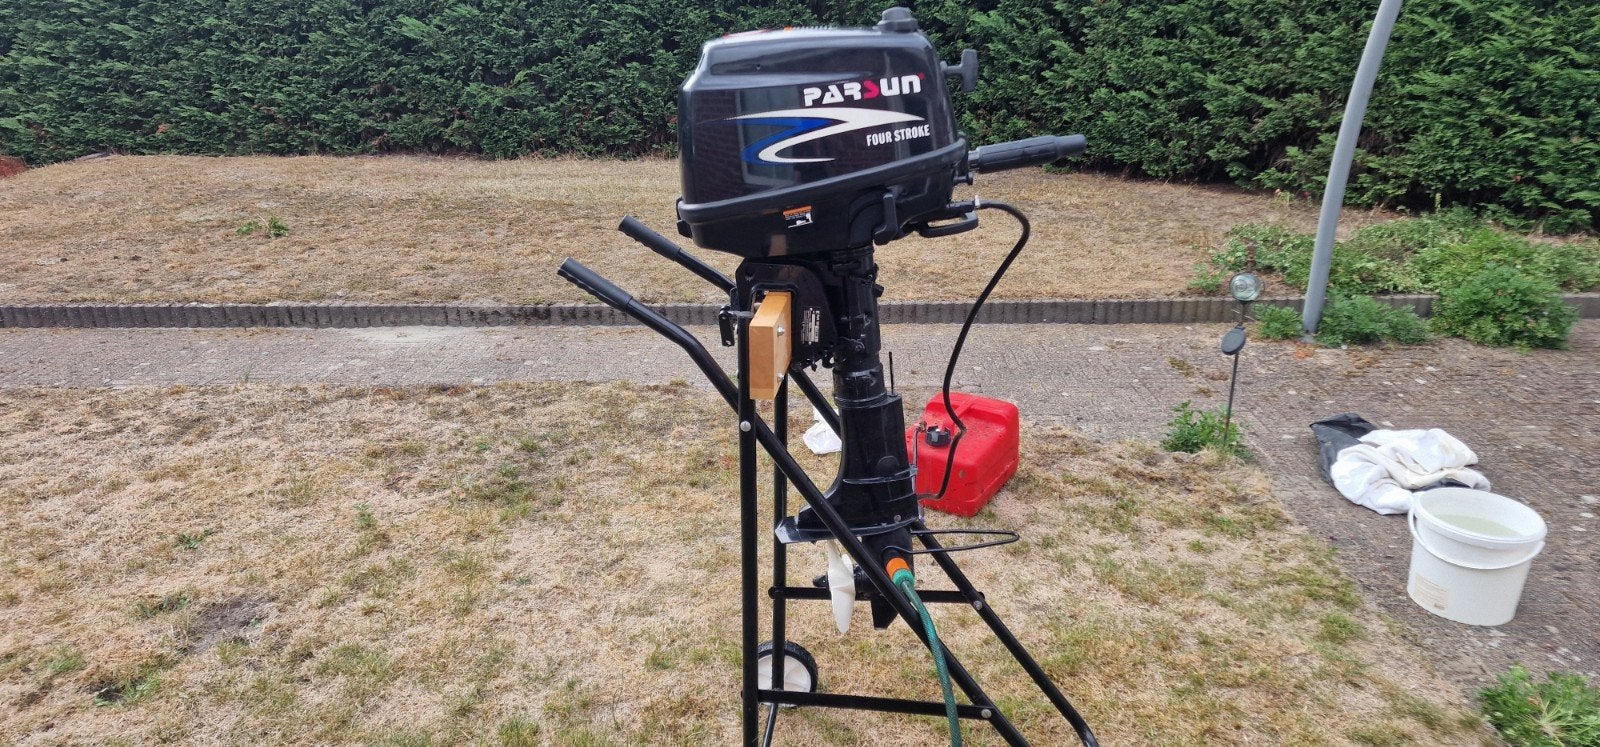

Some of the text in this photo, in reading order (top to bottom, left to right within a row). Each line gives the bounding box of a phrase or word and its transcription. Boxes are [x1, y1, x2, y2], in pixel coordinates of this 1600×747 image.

[803, 75, 921, 107] PARSUN
[866, 124, 931, 146] FOUR STROKE
